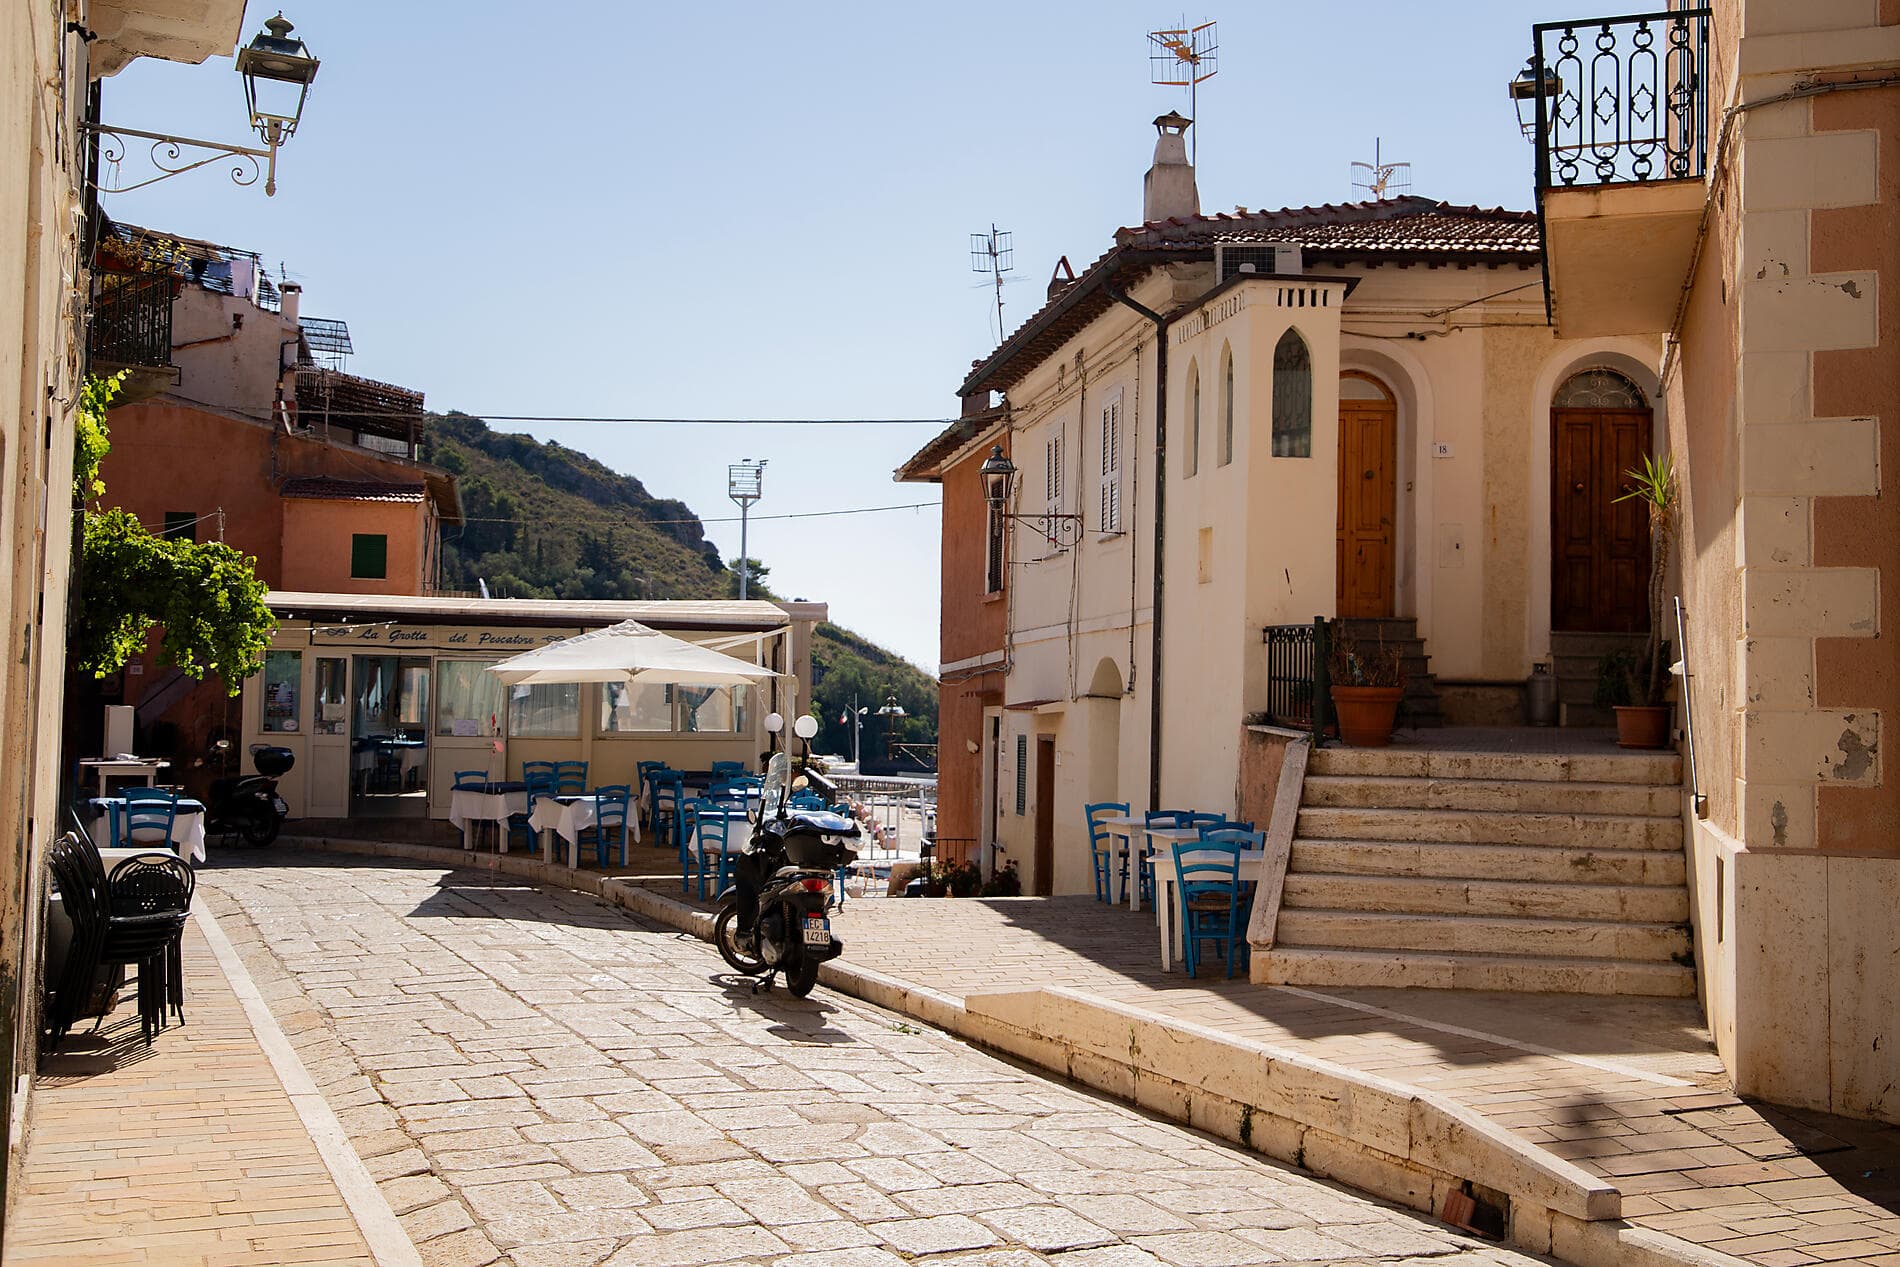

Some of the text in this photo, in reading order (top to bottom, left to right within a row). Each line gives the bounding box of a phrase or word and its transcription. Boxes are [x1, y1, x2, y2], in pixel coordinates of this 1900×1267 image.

[1439, 445, 1447, 454] 18
[358, 628, 535, 645] La Grotta del Pescatore
[806, 931, 829, 942] 14218
